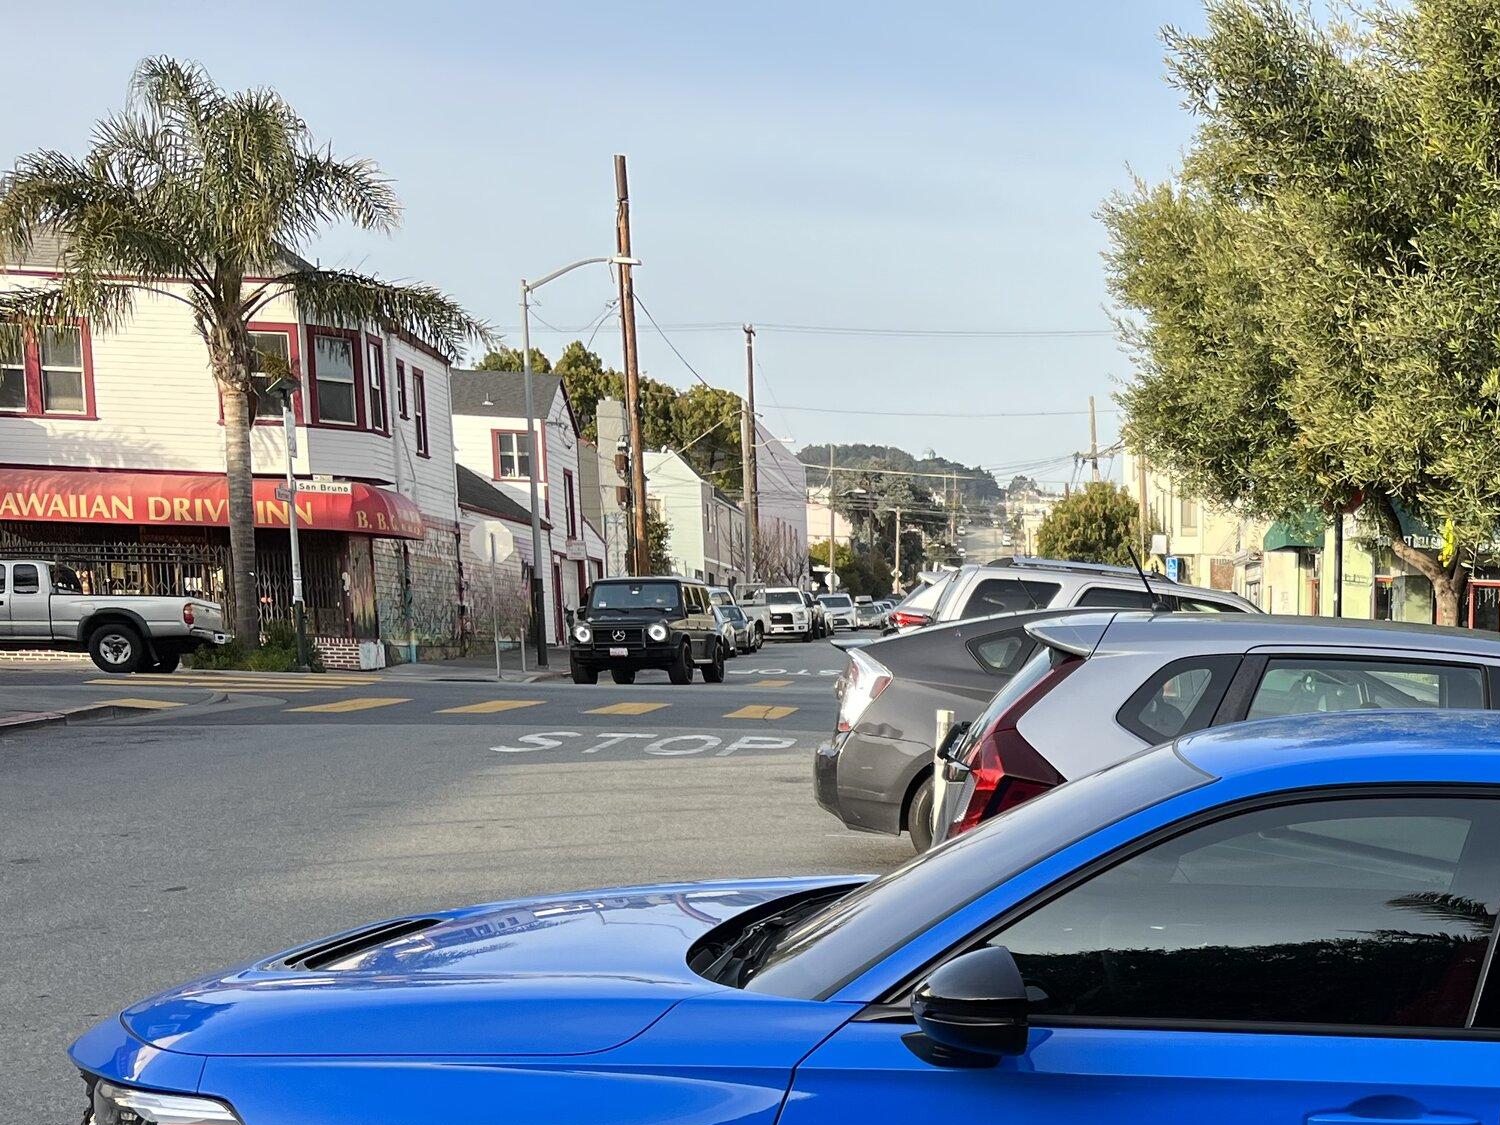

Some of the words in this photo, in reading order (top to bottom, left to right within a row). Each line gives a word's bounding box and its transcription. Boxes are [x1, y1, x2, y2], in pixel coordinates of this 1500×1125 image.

[299, 483, 317, 491] San
[320, 484, 349, 493] Bruno
[148, 496, 230, 522] DRIV
[489, 731, 799, 757] STOP
